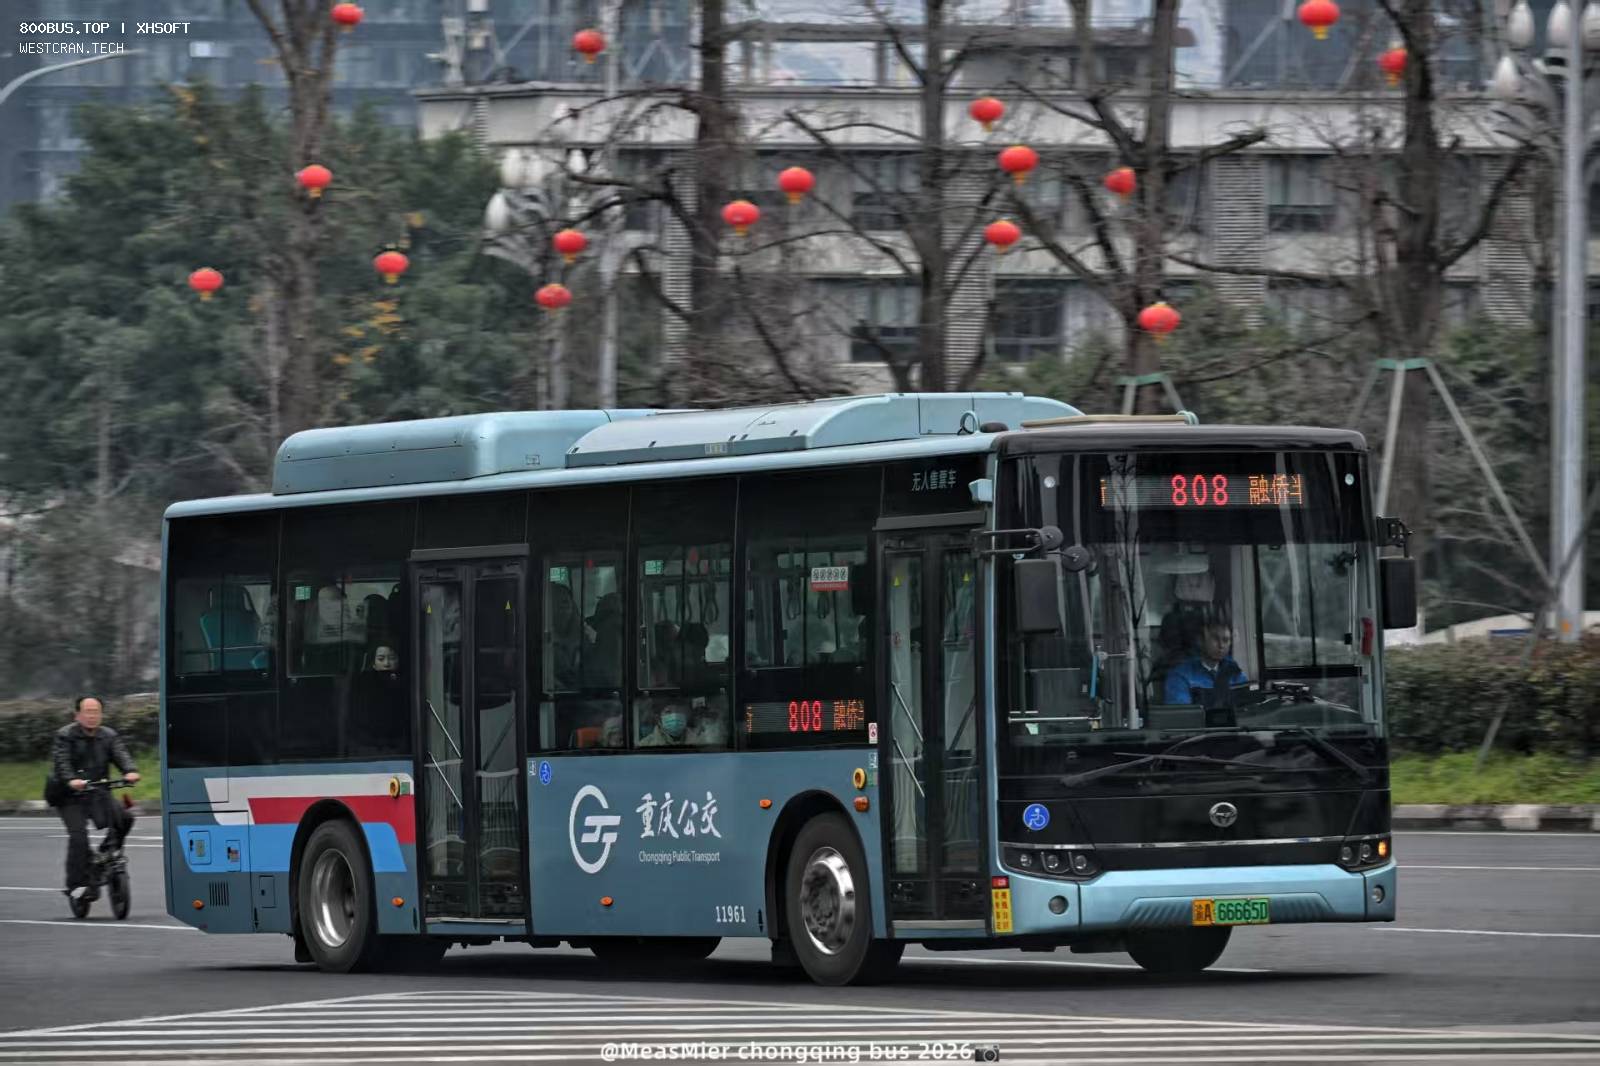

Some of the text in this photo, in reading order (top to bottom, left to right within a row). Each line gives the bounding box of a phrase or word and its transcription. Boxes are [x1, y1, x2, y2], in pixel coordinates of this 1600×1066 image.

[911, 469, 957, 491] 无人售票车
[1171, 474, 1228, 506] 808
[788, 700, 823, 732] 808
[635, 791, 722, 839] 重庆公交
[639, 850, 720, 865] Chongqing Public Transport
[715, 905, 746, 923] 11961
[1218, 901, 1268, 921] 66665D
